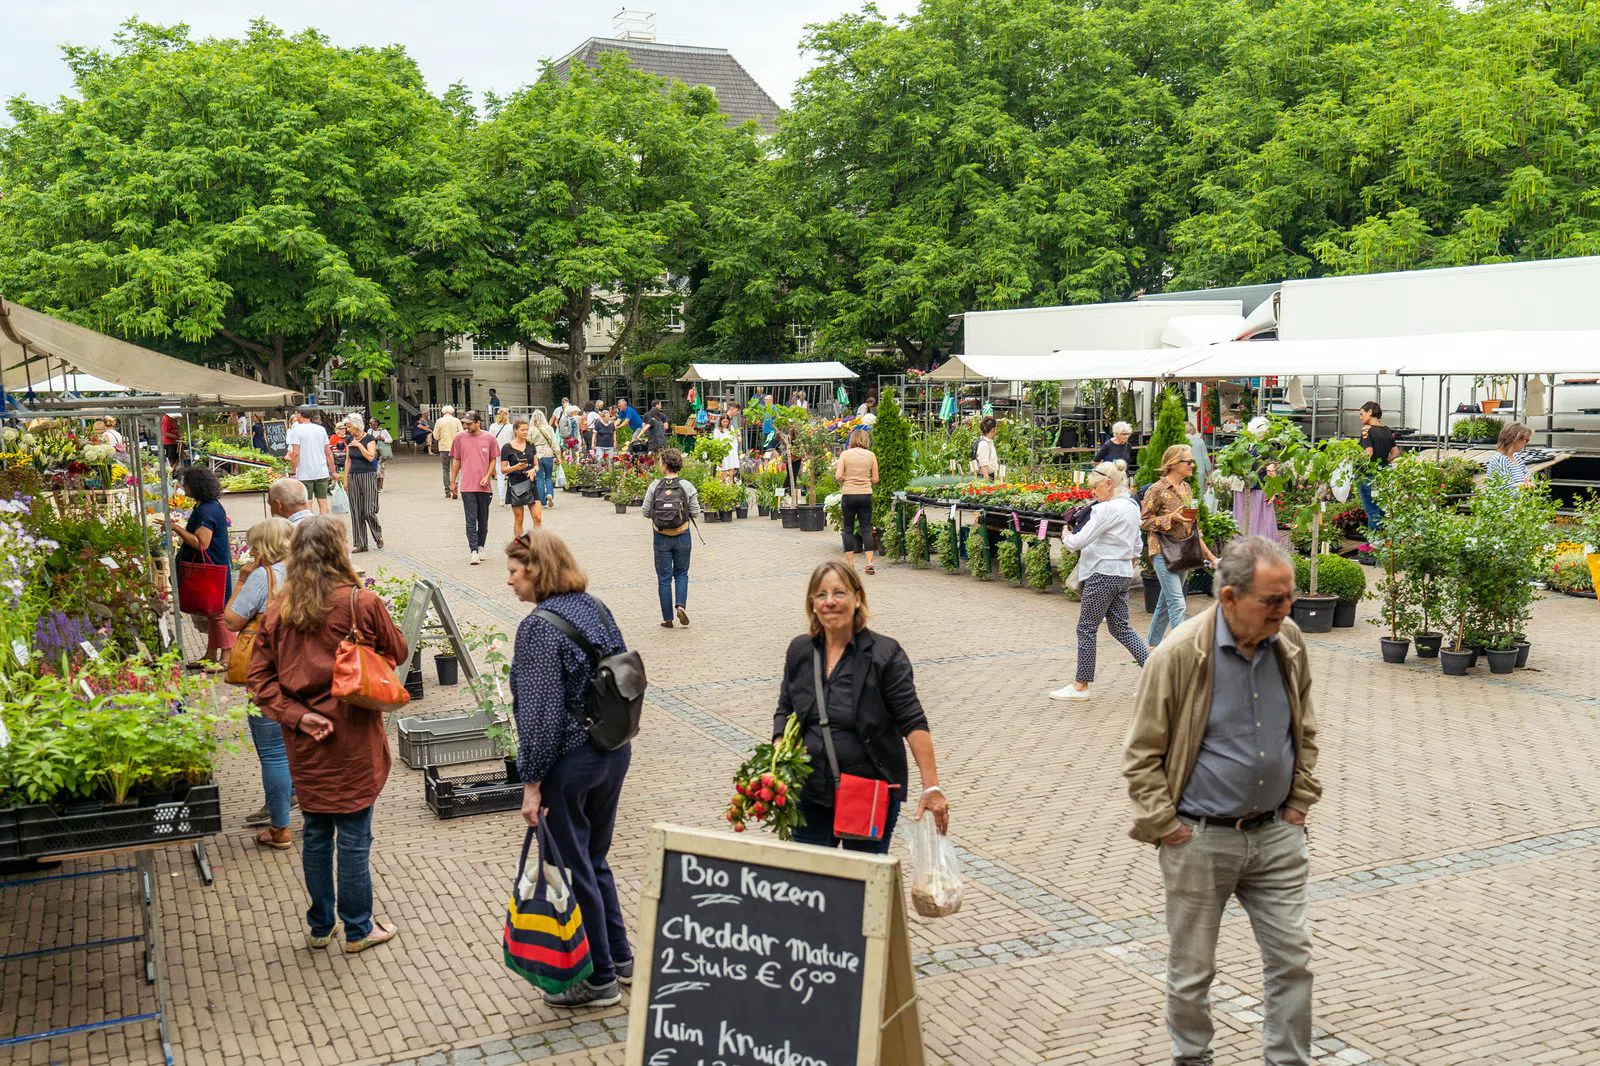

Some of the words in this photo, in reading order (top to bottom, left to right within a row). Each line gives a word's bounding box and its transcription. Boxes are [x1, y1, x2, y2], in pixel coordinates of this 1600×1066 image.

[681, 854, 729, 887] Bio
[662, 914, 779, 956] Cheddar
[661, 947, 680, 974] 2
[681, 952, 747, 981] Stuks
